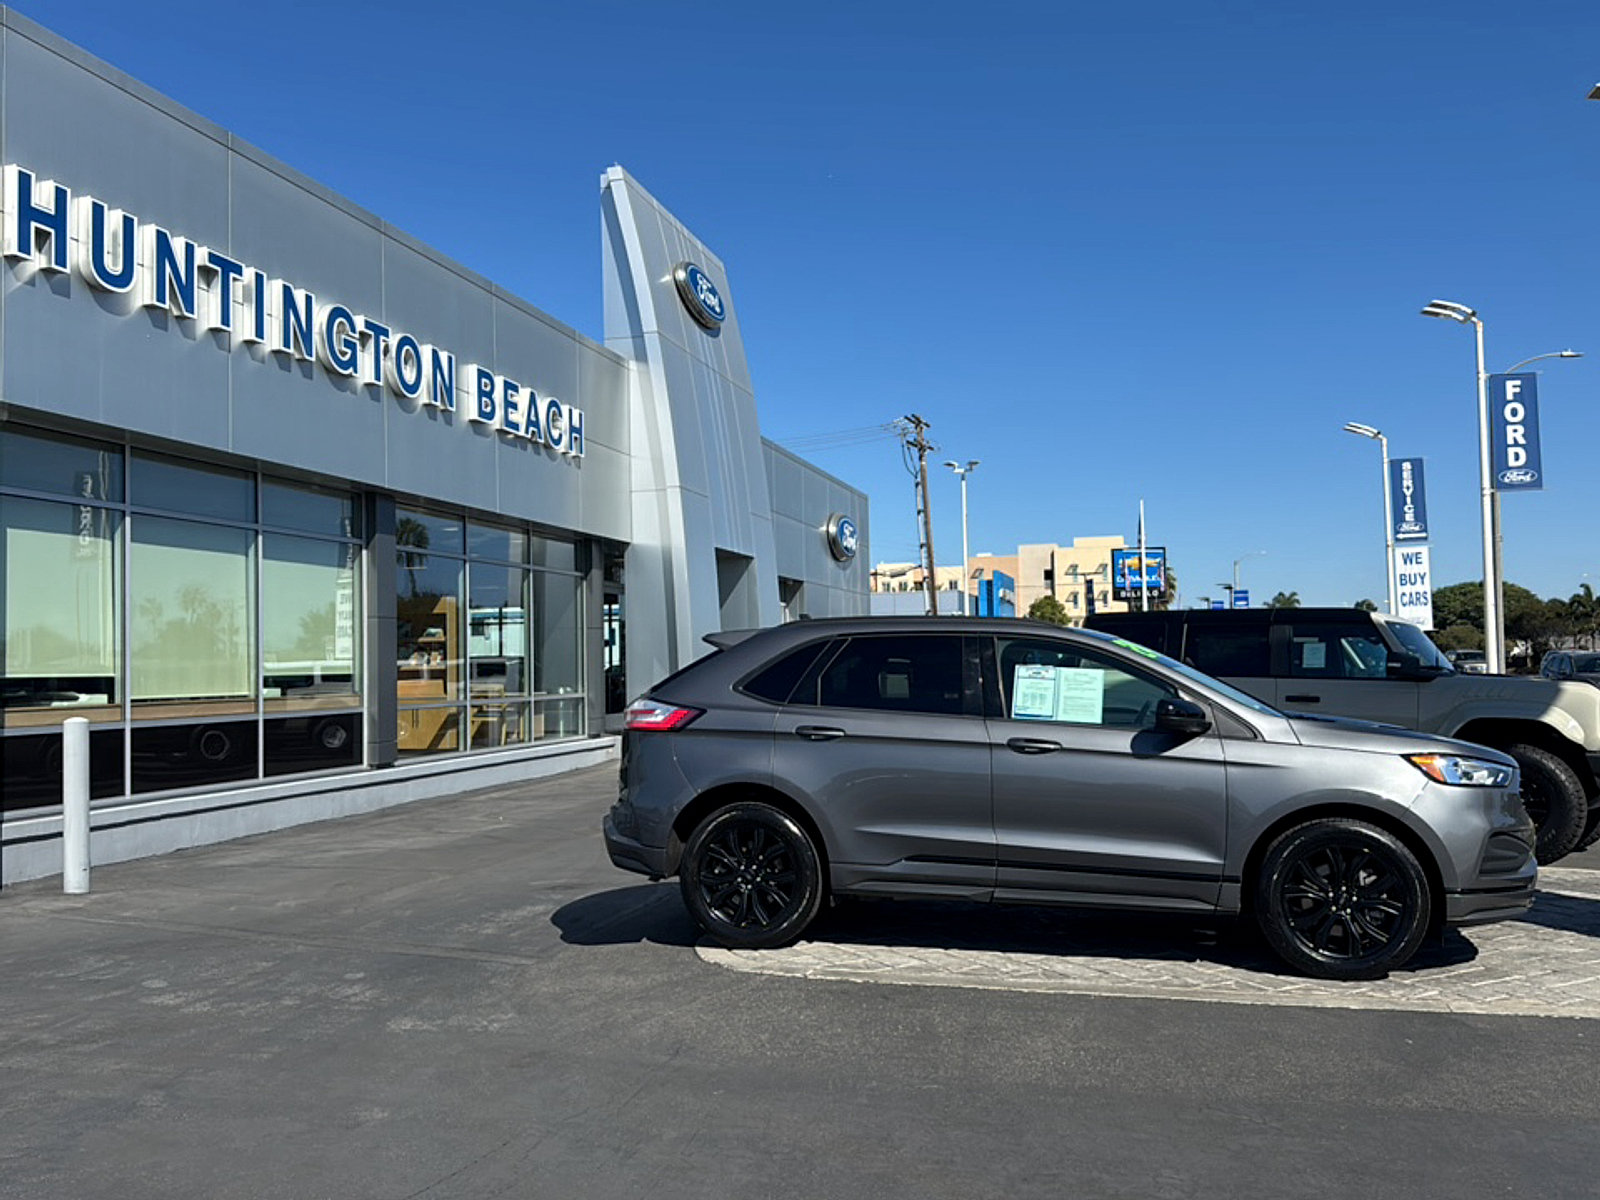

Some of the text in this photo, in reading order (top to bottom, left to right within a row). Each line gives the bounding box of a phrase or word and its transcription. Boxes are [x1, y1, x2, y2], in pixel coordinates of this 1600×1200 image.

[696, 273, 721, 313] Ford
[13, 166, 584, 457] HUNTINGTON BEACH
[1504, 379, 1527, 468] FORD
[1402, 552, 1423, 565] WE
[1400, 573, 1427, 586] BUY
[1400, 592, 1429, 607] CARS
